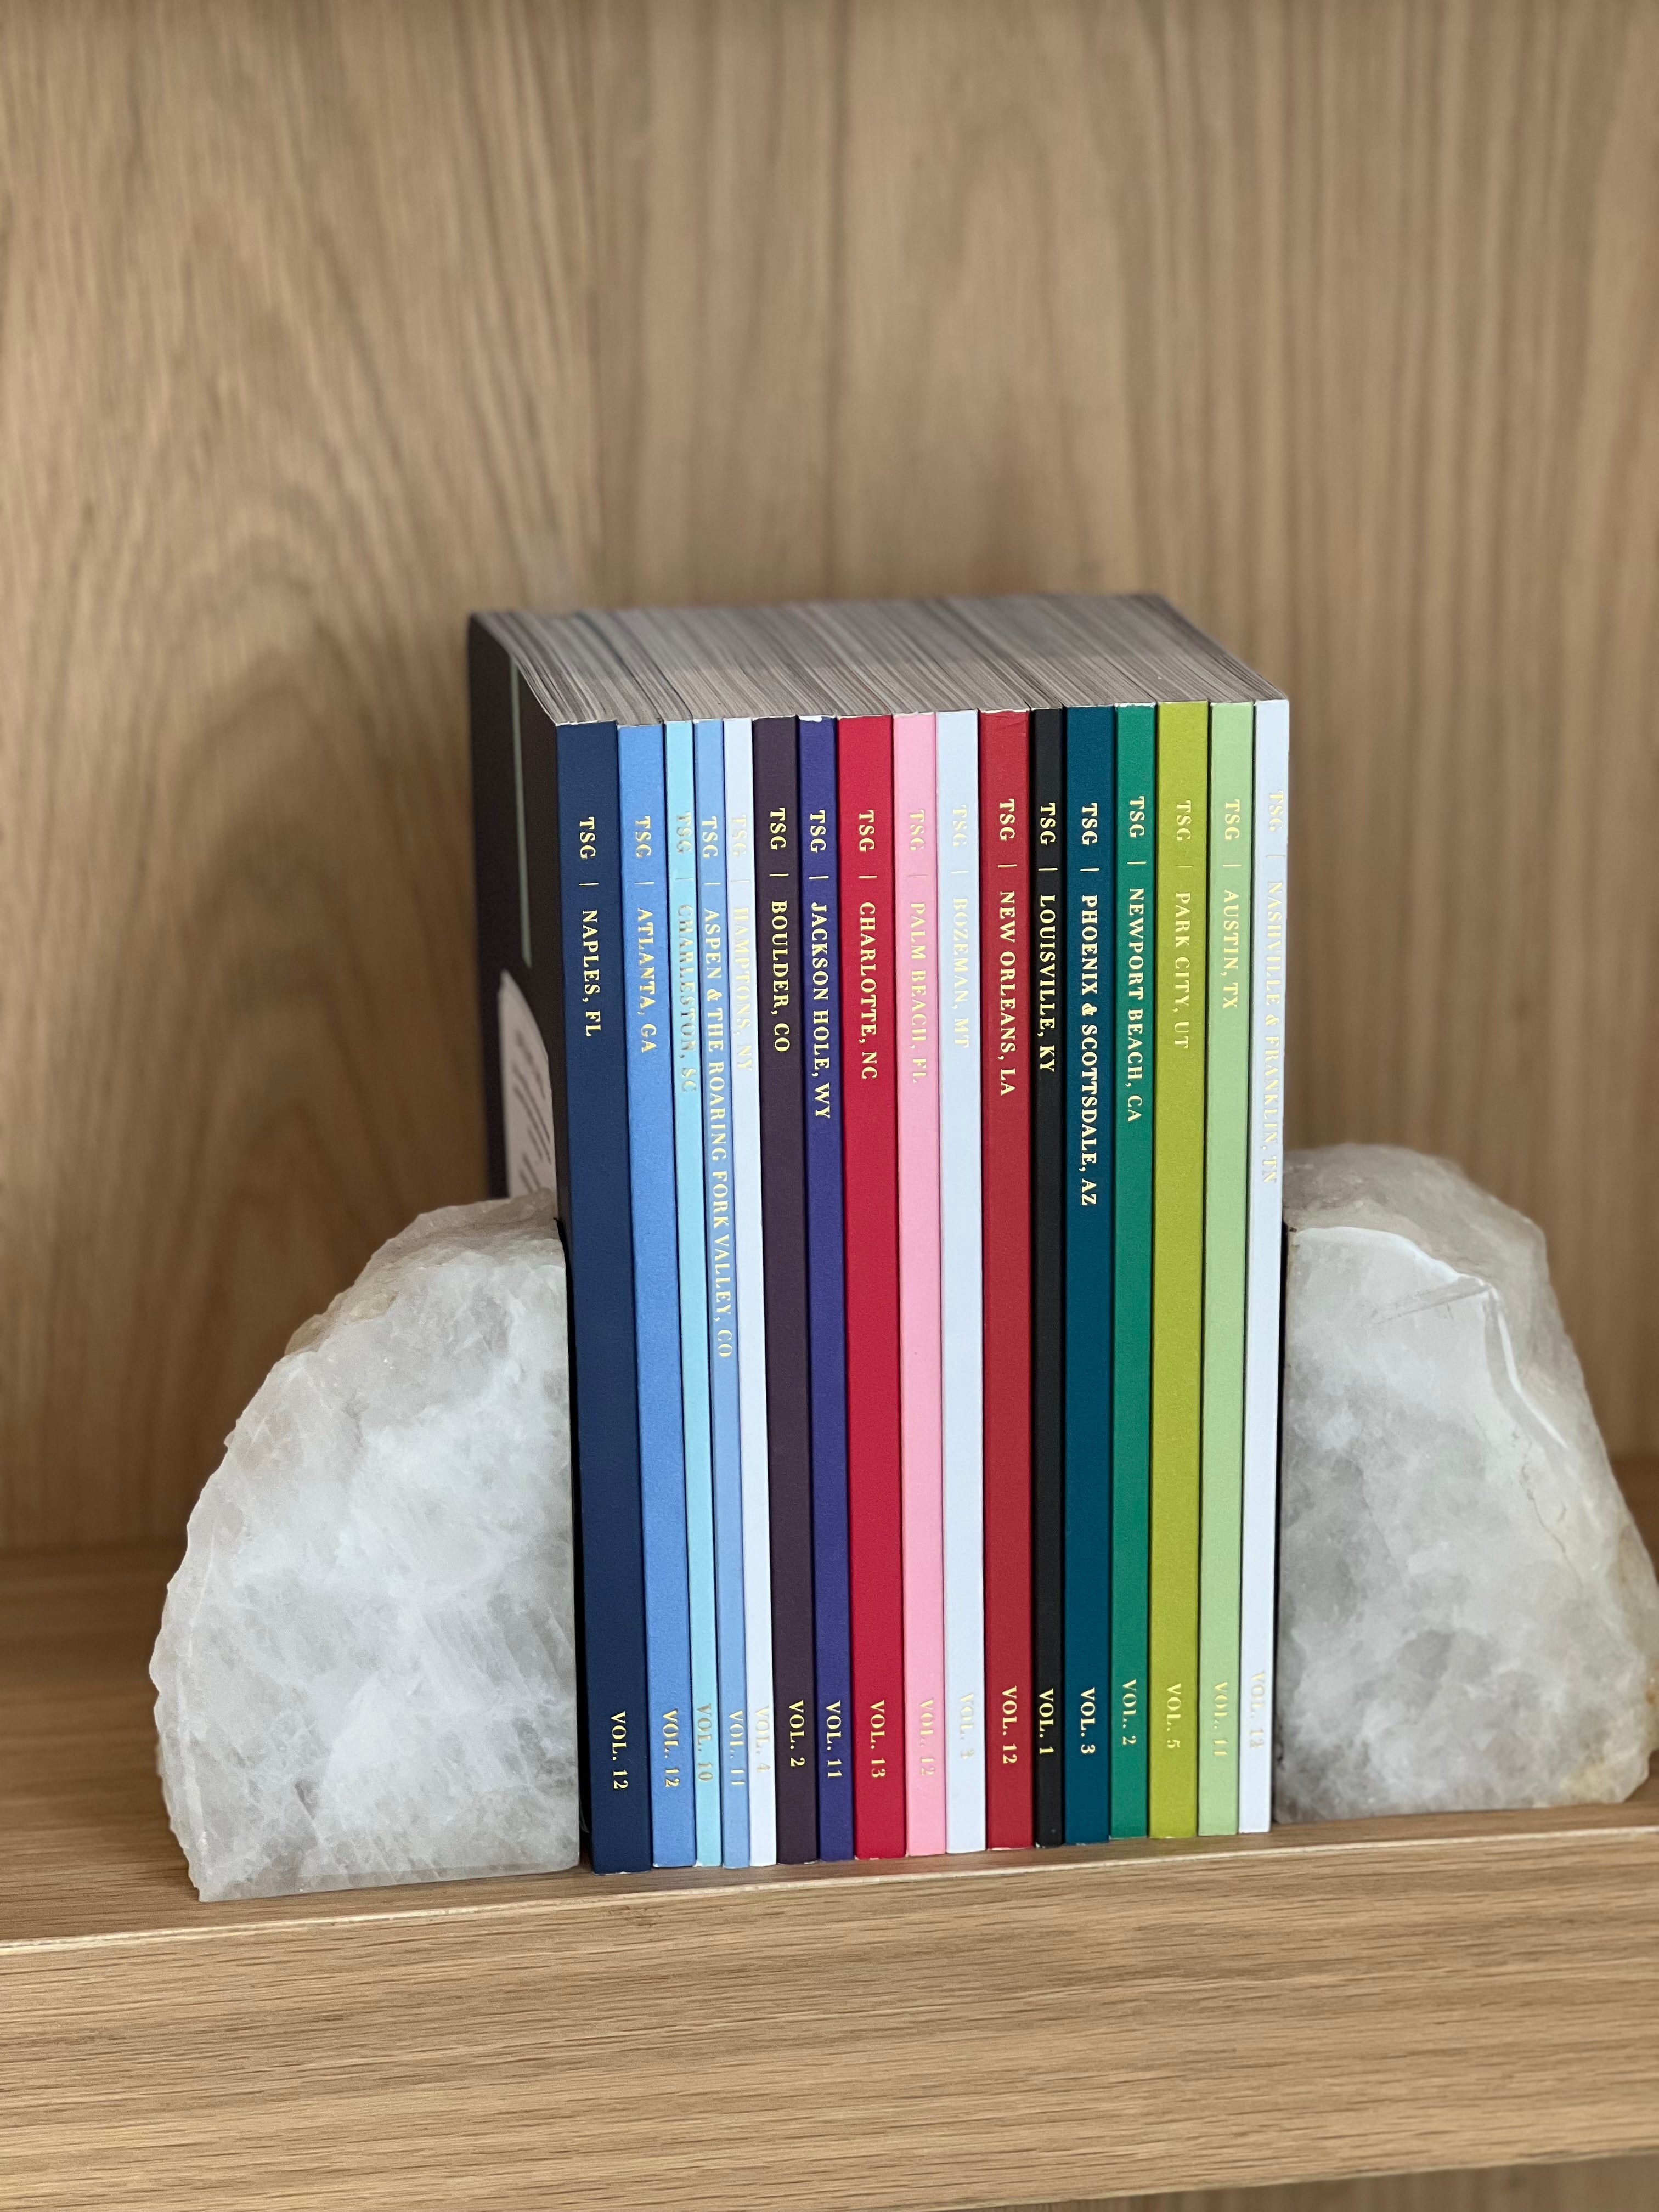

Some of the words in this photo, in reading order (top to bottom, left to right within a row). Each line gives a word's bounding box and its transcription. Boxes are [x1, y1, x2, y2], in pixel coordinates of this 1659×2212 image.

[579, 816, 596, 860] TSG
[635, 815, 652, 858] TSG
[676, 811, 692, 855] TSG
[702, 816, 718, 859] TSG
[731, 814, 747, 857] TSG
[770, 807, 786, 850] TSG
[809, 809, 826, 853] TSG
[858, 809, 875, 853] TSG
[910, 809, 925, 851] TSG
[952, 804, 967, 847] TSG
[999, 798, 1016, 842] TSG
[1040, 802, 1056, 846] TSG
[1081, 803, 1098, 846] TSG
[1128, 796, 1146, 839] TSG
[1176, 800, 1192, 842] TSG
[1225, 799, 1240, 840] TSG
[910, 902, 926, 960] PALM
[1000, 891, 1017, 943] NEW
[1176, 893, 1191, 949] PARK
[1221, 889, 1240, 977] AUSTIN,
[582, 910, 600, 1003] NAPLES,
[637, 908, 656, 1016] ATLANTA,
[704, 908, 721, 979] ASPEN
[771, 900, 789, 1015] BOULDER,
[811, 901, 829, 1000] JACKSON
[952, 898, 969, 1009] BOZEMAN,
[1081, 895, 1098, 996] PHOENIX
[1128, 888, 1144, 1000] NEWPORT
[676, 904, 696, 1059] CHARLESTON,
[733, 906, 752, 1037] HAMPTONS,
[859, 901, 877, 1043] CHARLOTTE,
[1037, 895, 1056, 1037] LOUISVILLE,
[1173, 956, 1192, 1013] CITY,
[707, 988, 723, 1002] &
[910, 969, 927, 1049] BEACH,
[998, 950, 1017, 1060] ORLEANS,
[1081, 1003, 1096, 1017] &
[1223, 982, 1238, 1010] TX
[585, 1011, 601, 1037] FL
[640, 1023, 657, 1053] GA
[707, 1007, 724, 1052] THE
[774, 1023, 791, 1052] CO
[811, 1009, 830, 1077] HOLE,
[954, 1018, 969, 1048] MT
[1174, 1021, 1189, 1049] UT
[737, 1045, 753, 1071] NY
[861, 1051, 877, 1080] NC
[1040, 1045, 1056, 1073] KY
[1126, 1008, 1143, 1087] BEACH,
[681, 1066, 697, 1093] SC
[912, 1057, 927, 1084] FL
[1001, 1068, 1017, 1096] LA
[708, 1062, 727, 1161] ROARING
[815, 1082, 831, 1119] WY
[1079, 1024, 1097, 1172] SCOTTSDALE,
[1127, 1094, 1143, 1123] CA
[712, 1170, 729, 1229] FORK
[1081, 1177, 1096, 1205] AZ
[713, 1234, 732, 1322] VALLEY,
[717, 1328, 733, 1357] CO
[788, 1700, 804, 1750] VOL.
[825, 1700, 841, 1751] VOL.
[870, 1700, 885, 1751] VOL.
[919, 1698, 934, 1748] VOL.
[959, 1693, 975, 1741] VOL.
[1002, 1685, 1017, 1736] VOL.
[1039, 1688, 1054, 1739] VOL.
[1080, 1687, 1096, 1737] VOL.
[1122, 1679, 1137, 1729] VOL.
[1166, 1683, 1182, 1732] VOL.
[1214, 1681, 1228, 1730] VOL.
[610, 1710, 628, 1762] VOL.
[662, 1709, 679, 1759] VOL.
[697, 1703, 713, 1752] VOL.
[729, 1709, 744, 1759] VOL.
[754, 1705, 769, 1754] VOL.
[1081, 1743, 1096, 1754] 3
[1122, 1735, 1137, 1745] 2
[1167, 1739, 1181, 1749] 5
[1214, 1740, 1228, 1756] 11
[697, 1762, 714, 1783] 10
[790, 1757, 805, 1767] 2
[827, 1758, 842, 1778] 11
[870, 1757, 886, 1779] 13
[921, 1757, 935, 1776] 12
[1002, 1743, 1018, 1764] 12
[1040, 1746, 1054, 1755] 1
[613, 1769, 629, 1791] 12
[664, 1768, 680, 1788] 12
[730, 1768, 745, 1786] 11
